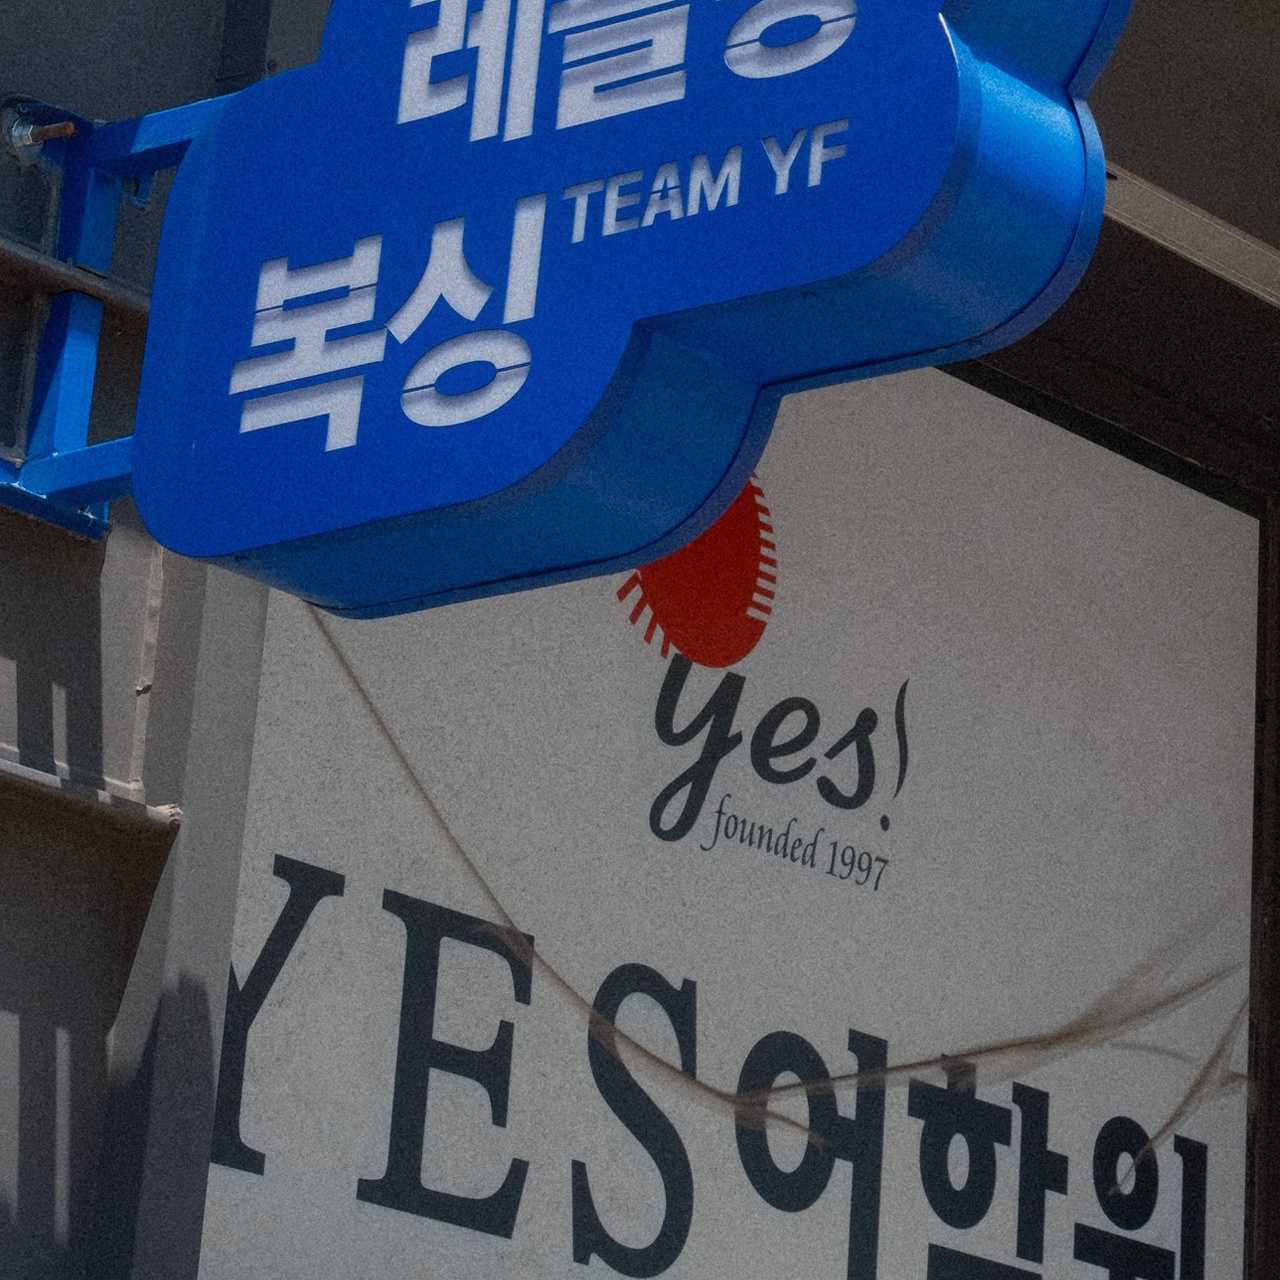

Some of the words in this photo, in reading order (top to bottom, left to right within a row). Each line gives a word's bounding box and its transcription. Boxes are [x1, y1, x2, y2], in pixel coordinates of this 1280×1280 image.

[561, 144, 744, 244] TEAM
[760, 117, 852, 196] YF
[228, 191, 549, 453] 복싱
[649, 653, 910, 842] yes!
[701, 793, 825, 869] founded
[825, 841, 890, 892] 1997
